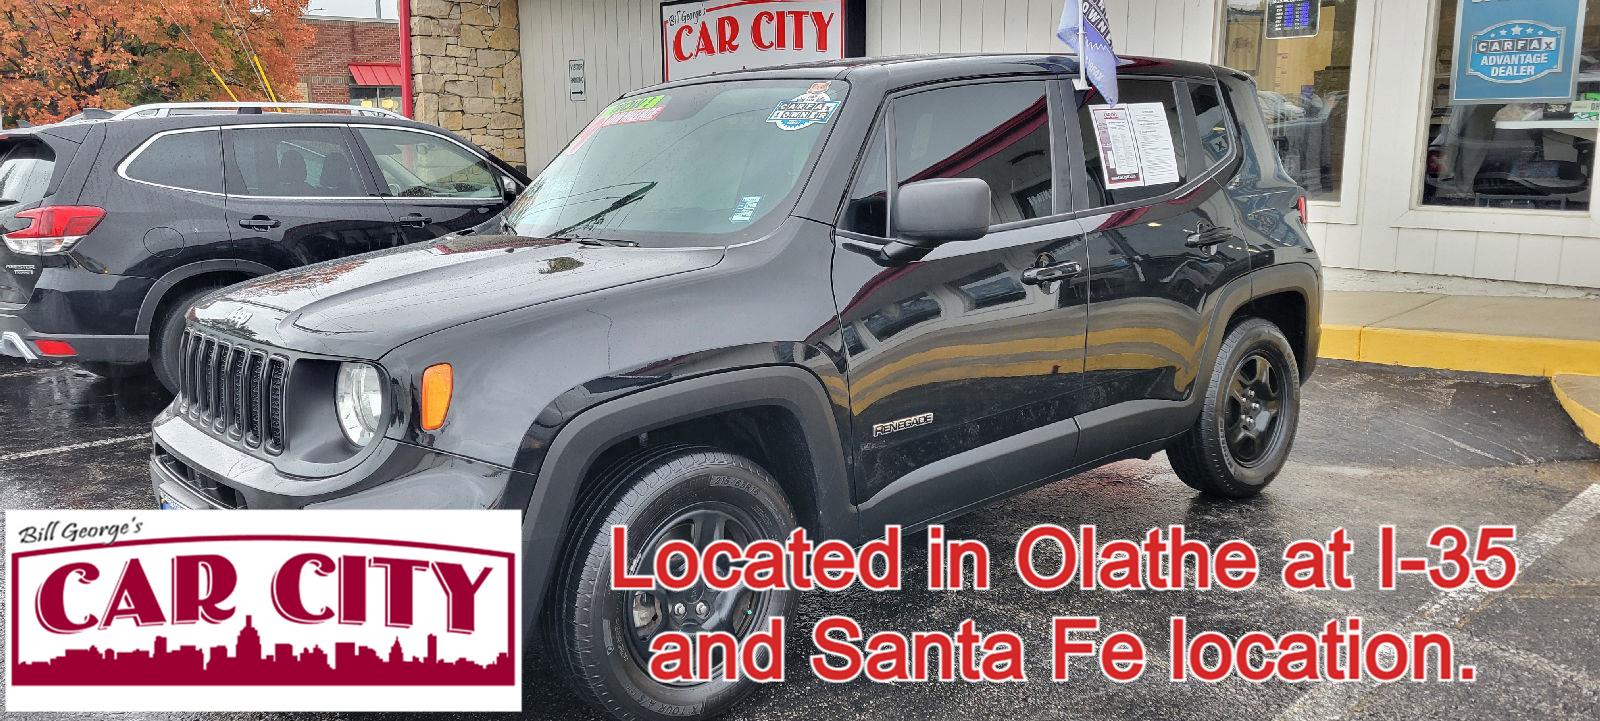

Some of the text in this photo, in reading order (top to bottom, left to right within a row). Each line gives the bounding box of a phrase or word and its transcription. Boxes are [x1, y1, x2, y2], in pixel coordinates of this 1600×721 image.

[673, 10, 834, 62] CAR CITY
[1477, 38, 1556, 53] CARFAX
[1480, 53, 1548, 66] ADVANTAGE
[1490, 65, 1535, 77] DEALER
[780, 102, 835, 111] CARFAX
[873, 412, 934, 438] RENEGADE
